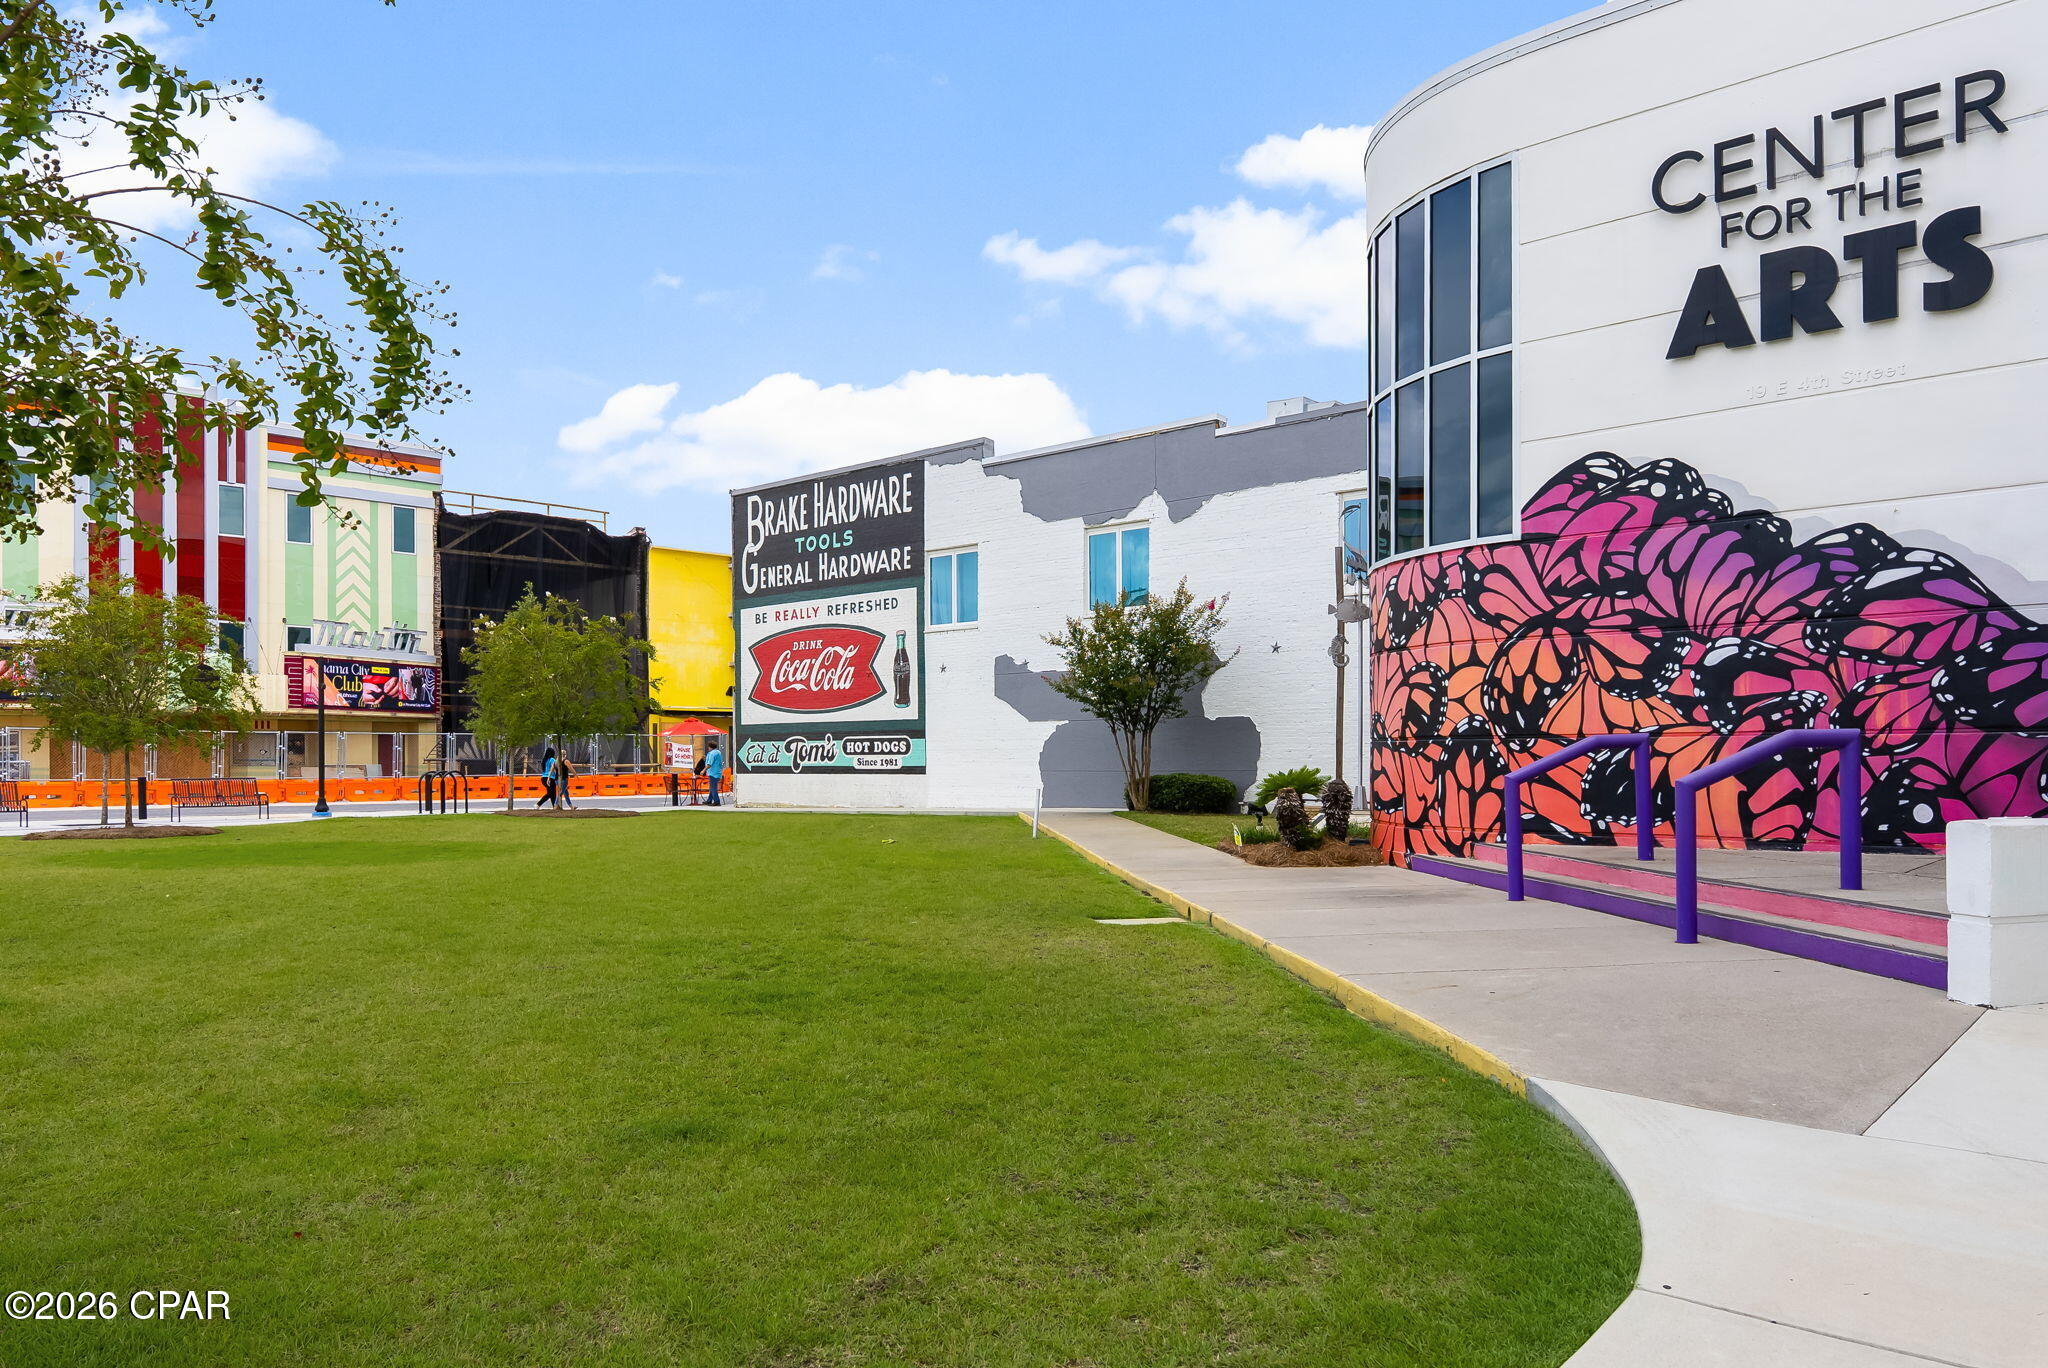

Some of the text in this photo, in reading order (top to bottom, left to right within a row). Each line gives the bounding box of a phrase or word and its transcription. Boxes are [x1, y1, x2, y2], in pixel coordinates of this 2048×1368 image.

[1651, 69, 2008, 215] CENTER
[1721, 168, 1923, 249] FOR THE
[1665, 205, 1994, 360] ARTS
[1746, 362, 1907, 399] 19 E 4th Street
[747, 473, 912, 554] BRAKE HARDWARE
[795, 529, 853, 553] TOOLS
[742, 543, 911, 594] GENERAL HARDWARE
[755, 597, 899, 624] BE REALLY REFRESHED
[313, 619, 427, 655] Martin
[793, 639, 823, 650] DRINK
[333, 675, 363, 692] Club
[351, 663, 370, 676] City
[747, 734, 907, 773] Eat at Tom's HOT DOGS
[857, 757, 899, 767] Since 1981
